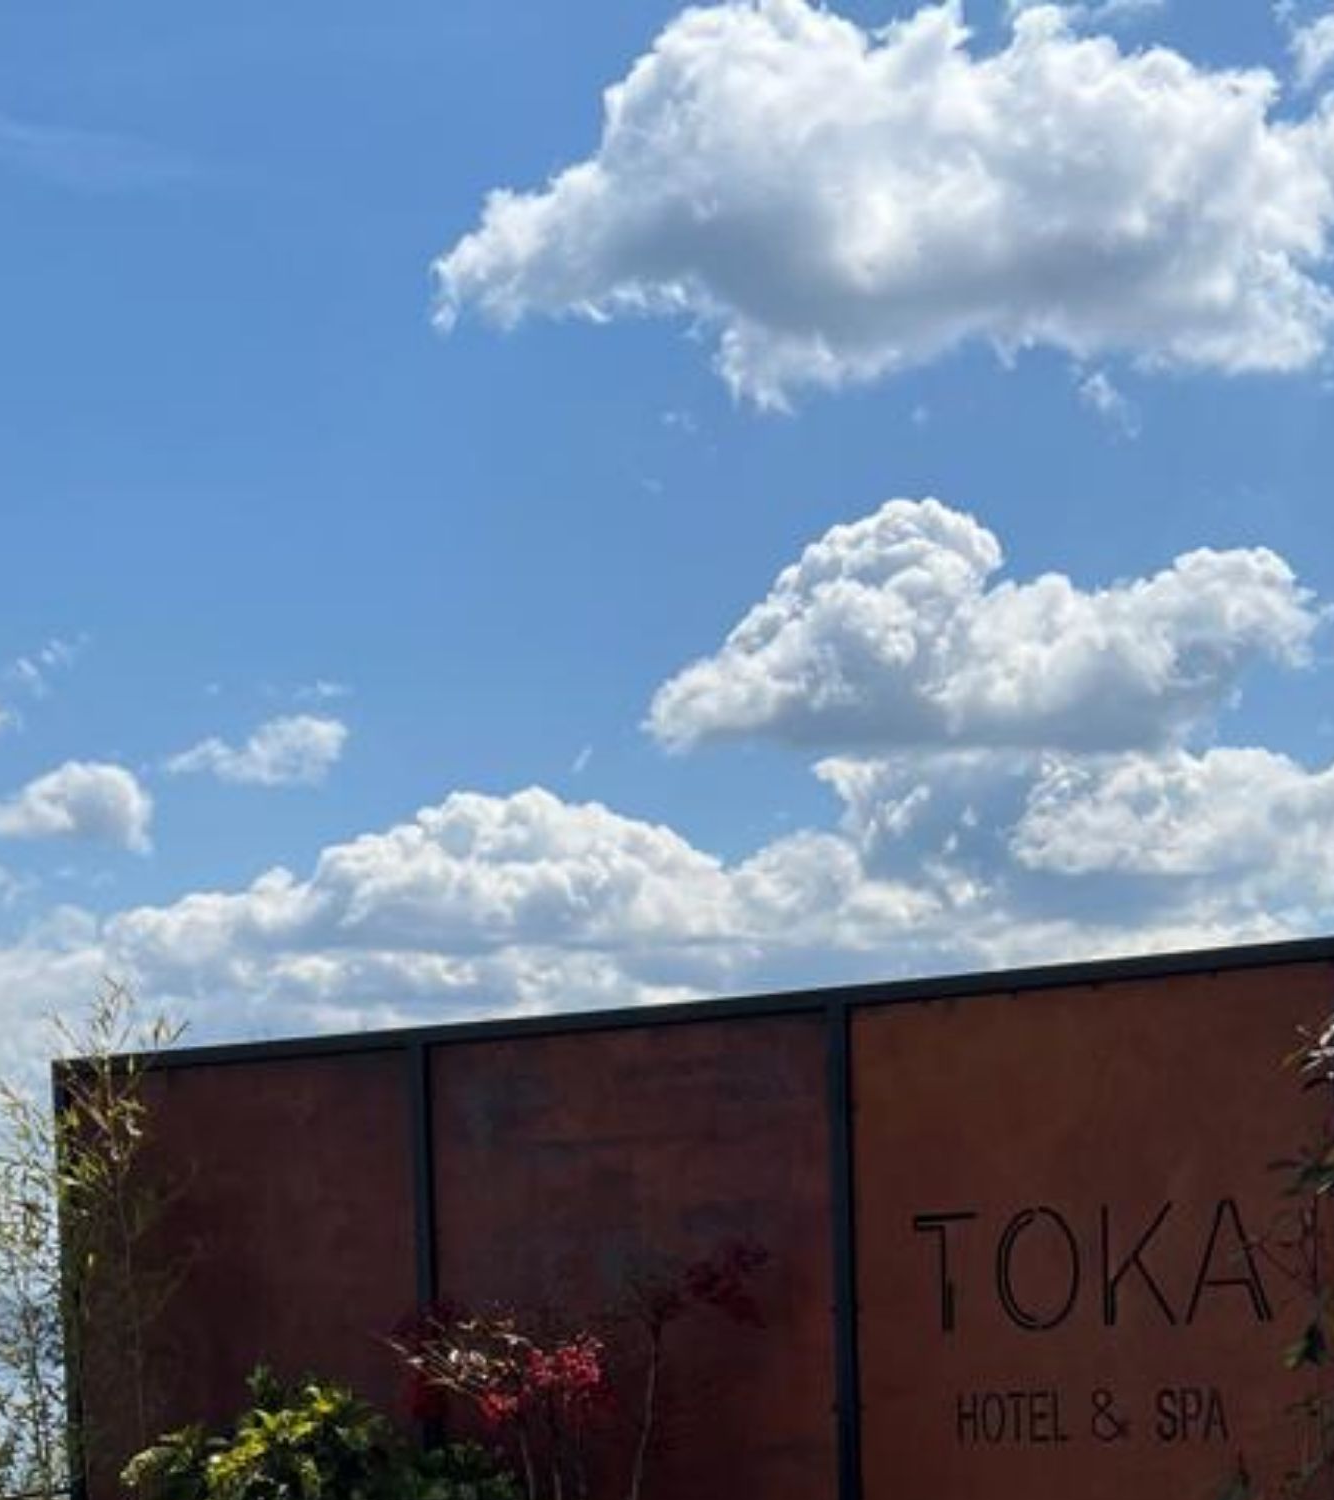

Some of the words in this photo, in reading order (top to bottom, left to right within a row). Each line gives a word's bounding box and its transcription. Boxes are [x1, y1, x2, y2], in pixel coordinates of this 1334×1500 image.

[913, 1197, 1273, 1332] TOKA
[957, 1390, 1067, 1442] HOTEL
[1092, 1388, 1128, 1442] &
[1156, 1388, 1229, 1442] SPA
